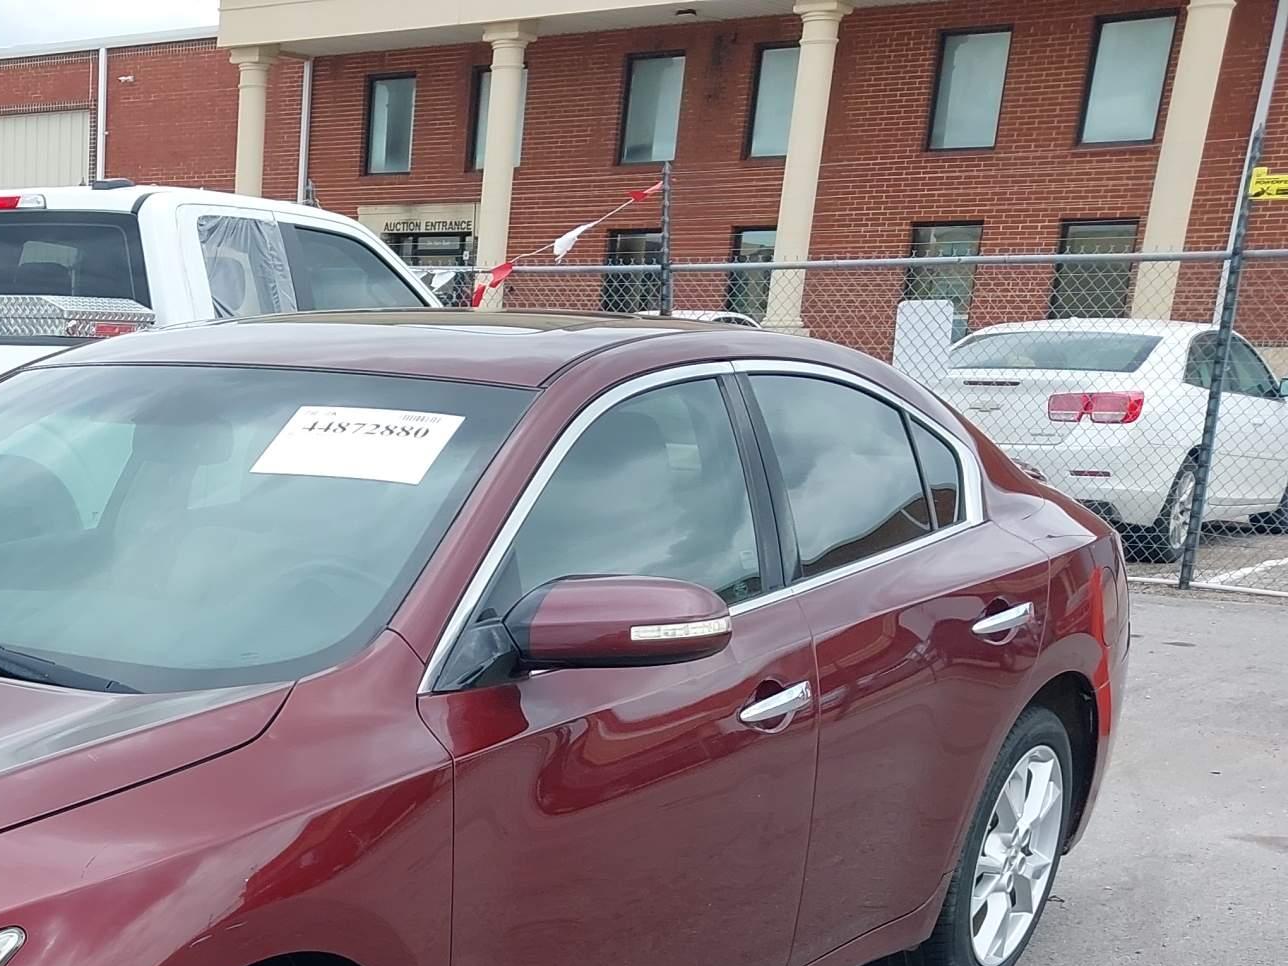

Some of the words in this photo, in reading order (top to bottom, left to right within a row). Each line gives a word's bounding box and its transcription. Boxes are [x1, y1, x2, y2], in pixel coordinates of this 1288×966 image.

[383, 220, 421, 232] AUCTION
[424, 220, 473, 232] ENTRANCE
[301, 420, 431, 439] 44872880
